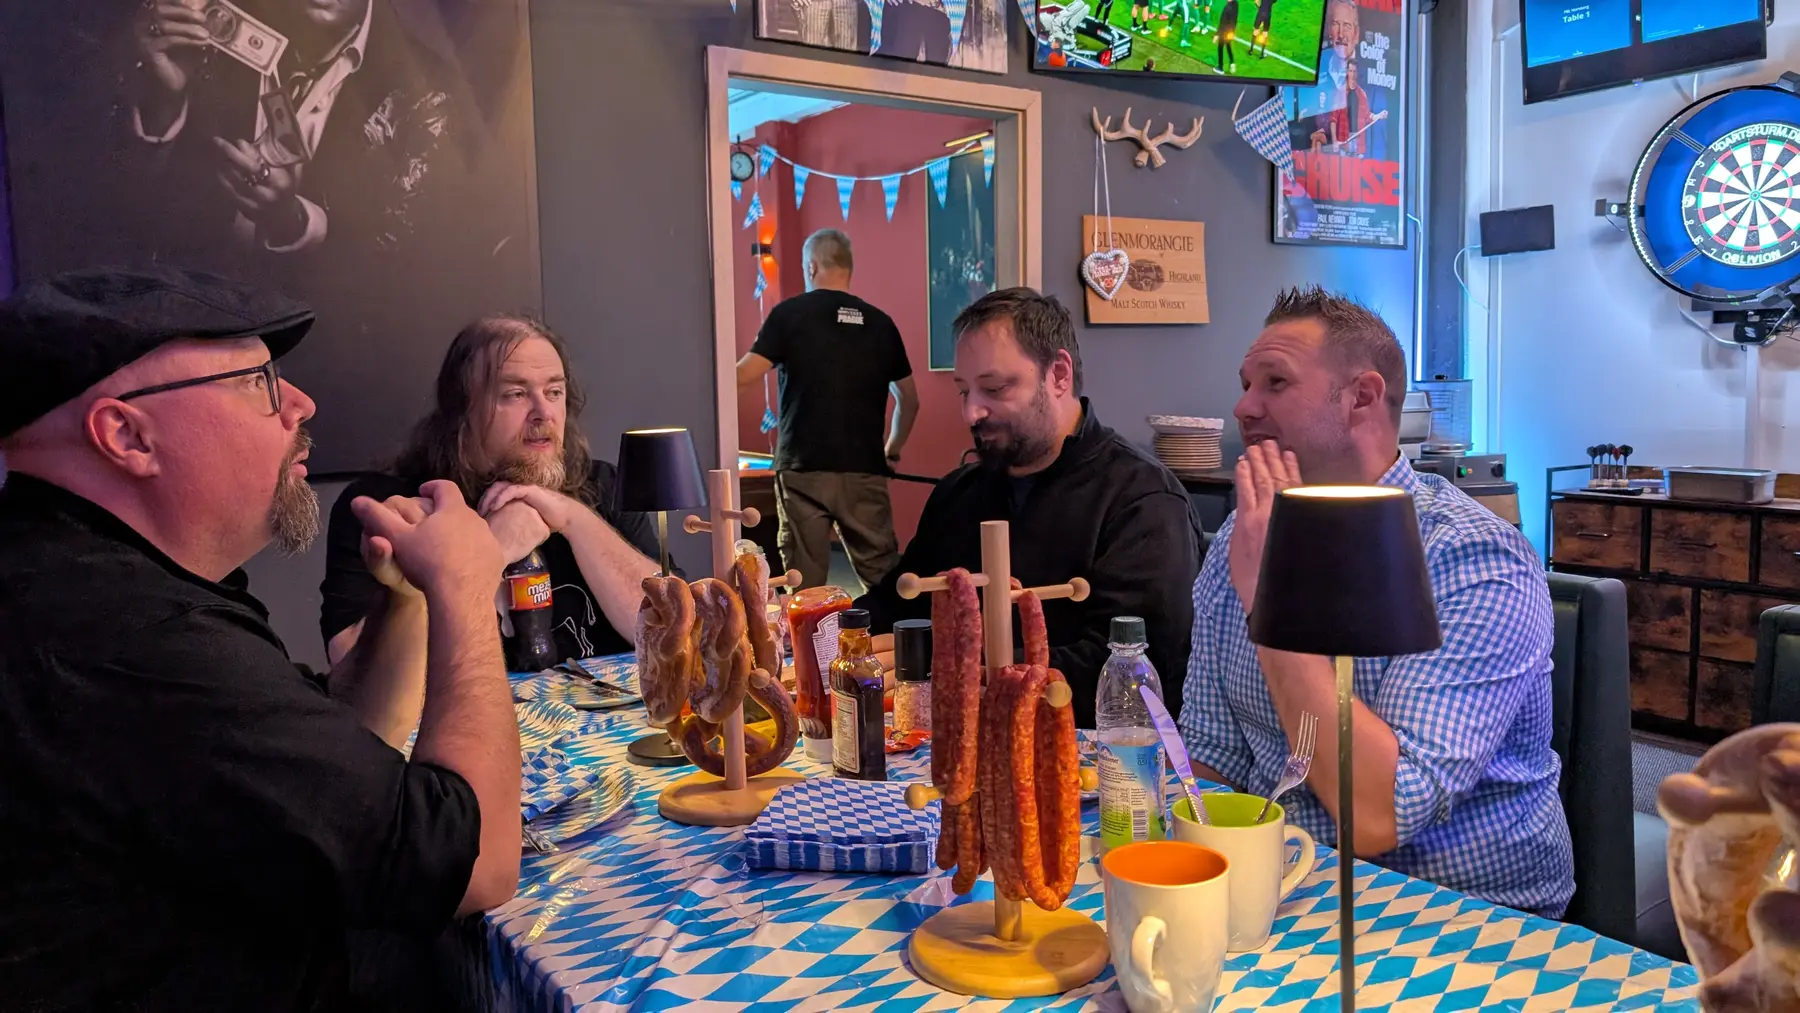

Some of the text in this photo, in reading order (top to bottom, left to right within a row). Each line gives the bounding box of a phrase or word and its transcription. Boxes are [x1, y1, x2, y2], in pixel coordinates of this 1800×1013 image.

[1562, 13, 1585, 23] Table
[1374, 32, 1390, 50] the
[1360, 41, 1385, 60] Color
[1376, 60, 1387, 74] of
[1367, 67, 1397, 91] Money
[1091, 231, 1194, 252] GLENMORANGIE
[1722, 249, 1781, 264] OBLIVION
